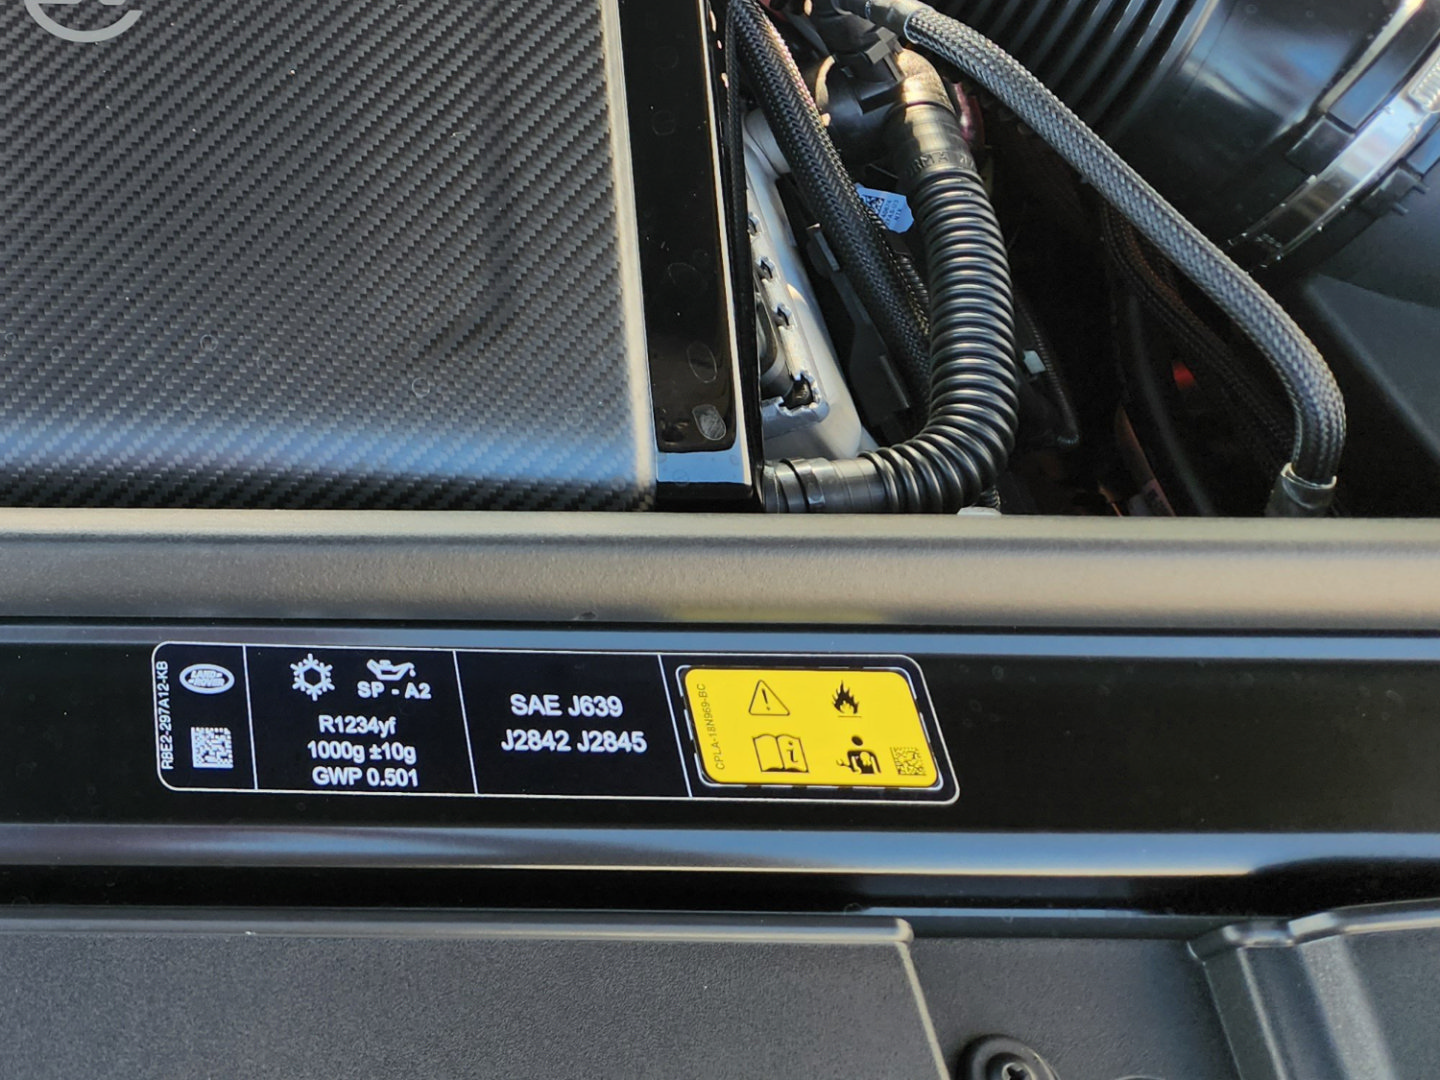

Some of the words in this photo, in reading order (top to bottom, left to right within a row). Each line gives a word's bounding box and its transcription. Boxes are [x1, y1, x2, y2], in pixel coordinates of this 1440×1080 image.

[357, 681, 386, 698] SP
[405, 682, 432, 700] A2
[510, 694, 562, 717] SAE
[567, 695, 623, 717] J639
[318, 715, 397, 736] R1234yf
[307, 740, 365, 763] 1000g
[369, 742, 417, 765] ±10g
[501, 729, 570, 752] J2842
[576, 730, 648, 754] J2845
[312, 767, 363, 785] GWP
[367, 768, 419, 787] 0.501
